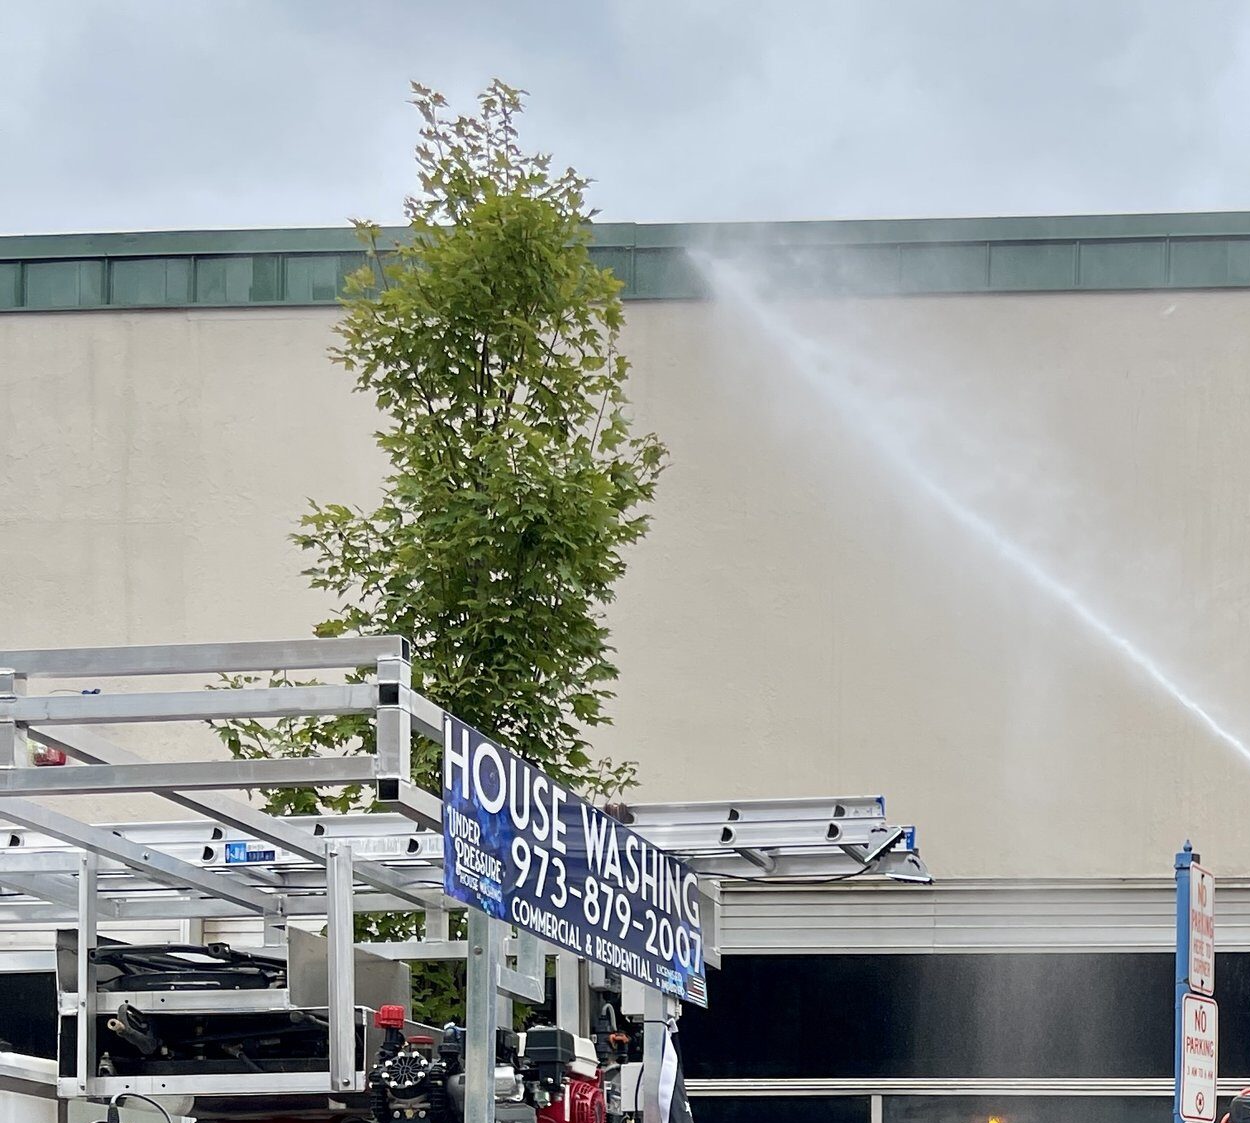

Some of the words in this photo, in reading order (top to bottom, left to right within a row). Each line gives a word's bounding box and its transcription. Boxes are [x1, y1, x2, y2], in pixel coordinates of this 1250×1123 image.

[445, 716, 567, 855] HOUSE
[580, 803, 700, 928] WASHING
[447, 805, 480, 847] UNDER
[455, 837, 502, 884] PRESSURE
[512, 837, 701, 974] 973-879-2007
[1197, 883, 1207, 908] NO
[512, 896, 582, 952] COMMERCIAL
[585, 933, 593, 956] &
[596, 937, 653, 984] RESIDENTIAL
[1191, 909, 1214, 939] PARKING
[1194, 1008, 1207, 1034] NO
[1186, 1036, 1214, 1058] PARKING
